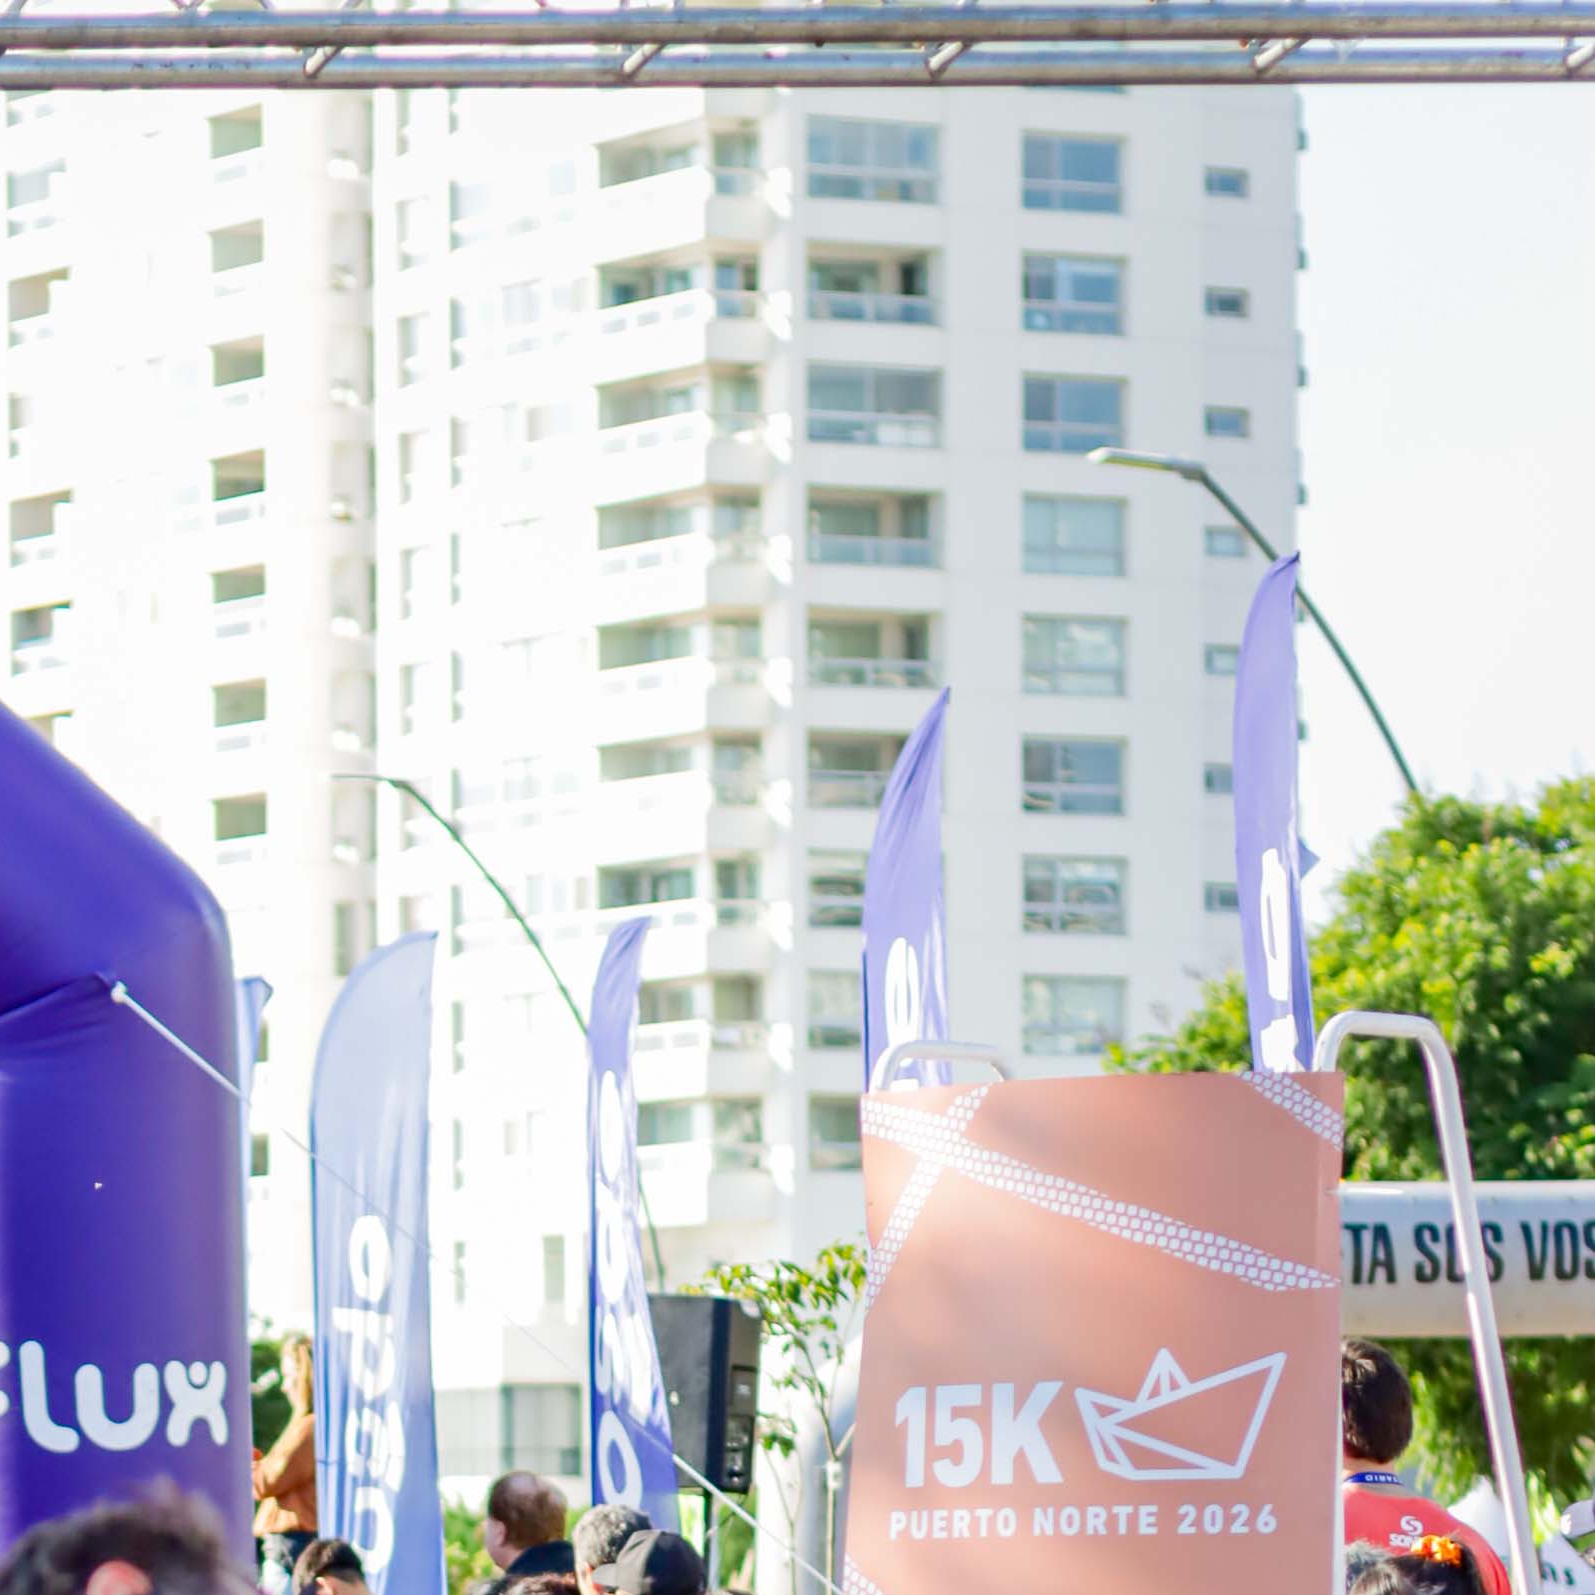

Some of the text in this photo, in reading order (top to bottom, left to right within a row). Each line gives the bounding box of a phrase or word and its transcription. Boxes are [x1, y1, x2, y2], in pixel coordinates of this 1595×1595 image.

[895, 1381, 1064, 1488] 15K
[889, 1504, 1278, 1541] PUERTO NORTE 2026
